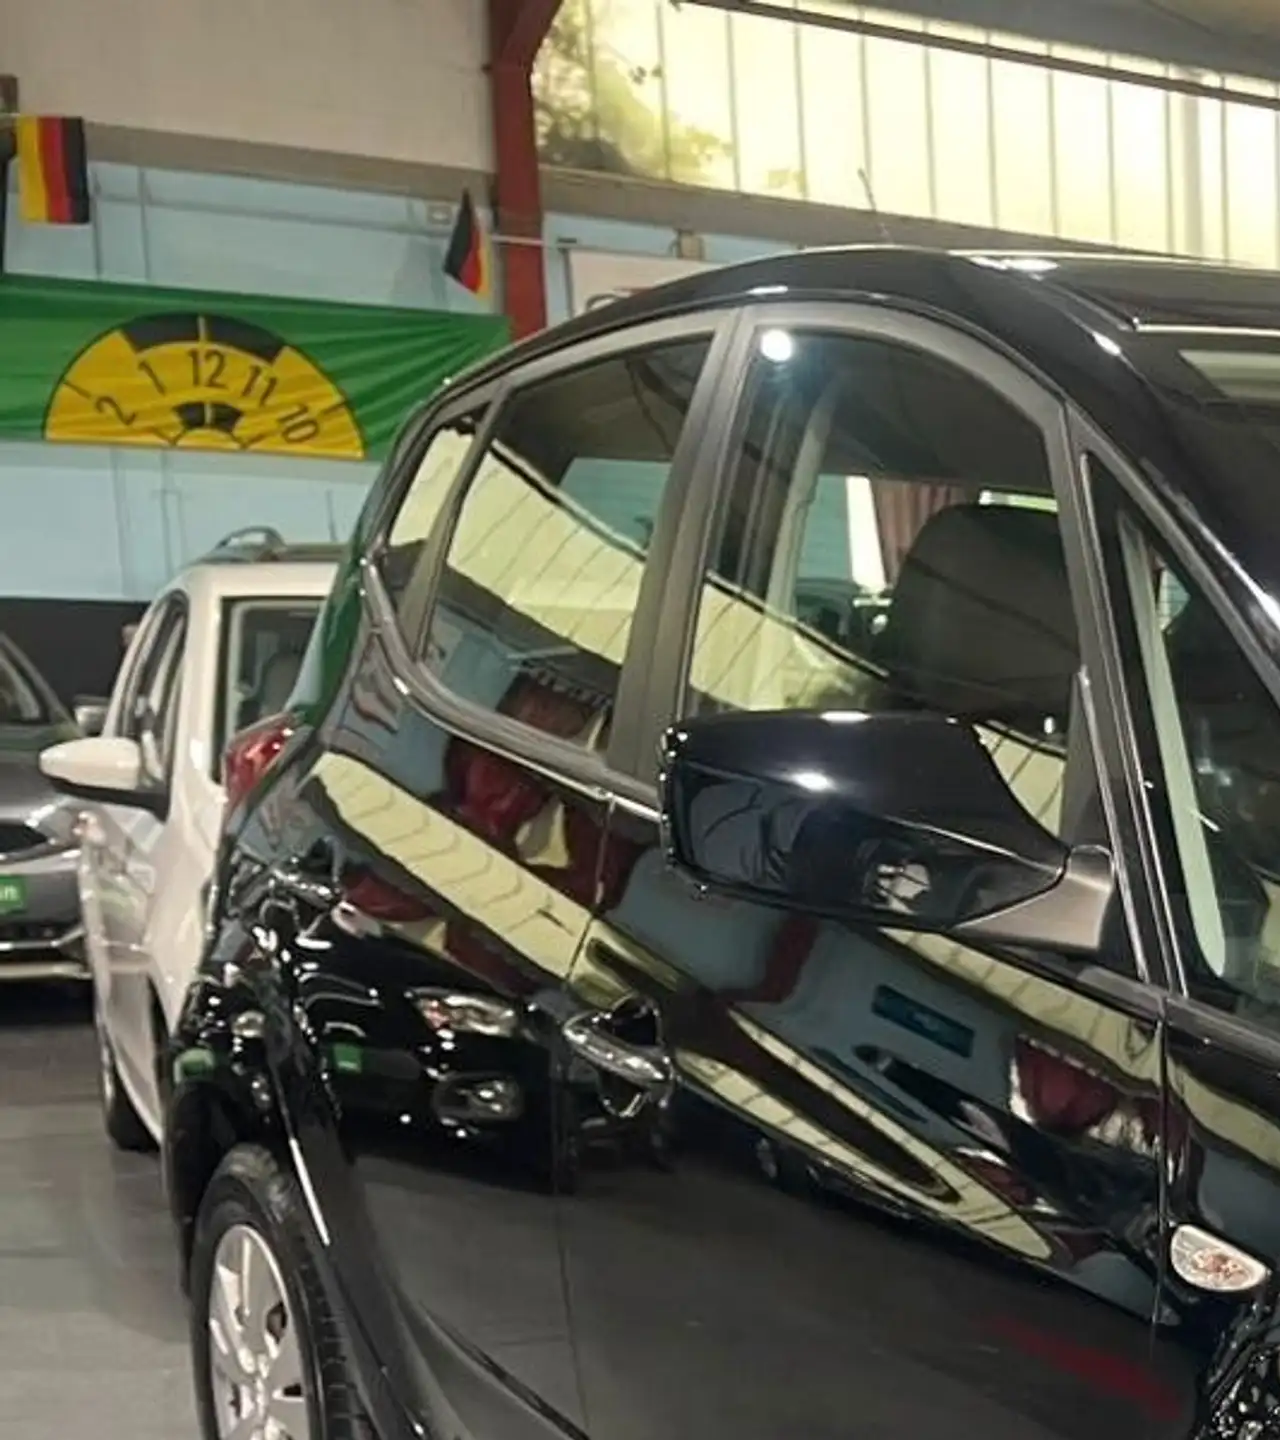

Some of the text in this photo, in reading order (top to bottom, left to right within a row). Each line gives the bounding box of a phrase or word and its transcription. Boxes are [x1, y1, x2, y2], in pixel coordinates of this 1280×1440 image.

[94, 348, 322, 445] 2 1 12 11 10
